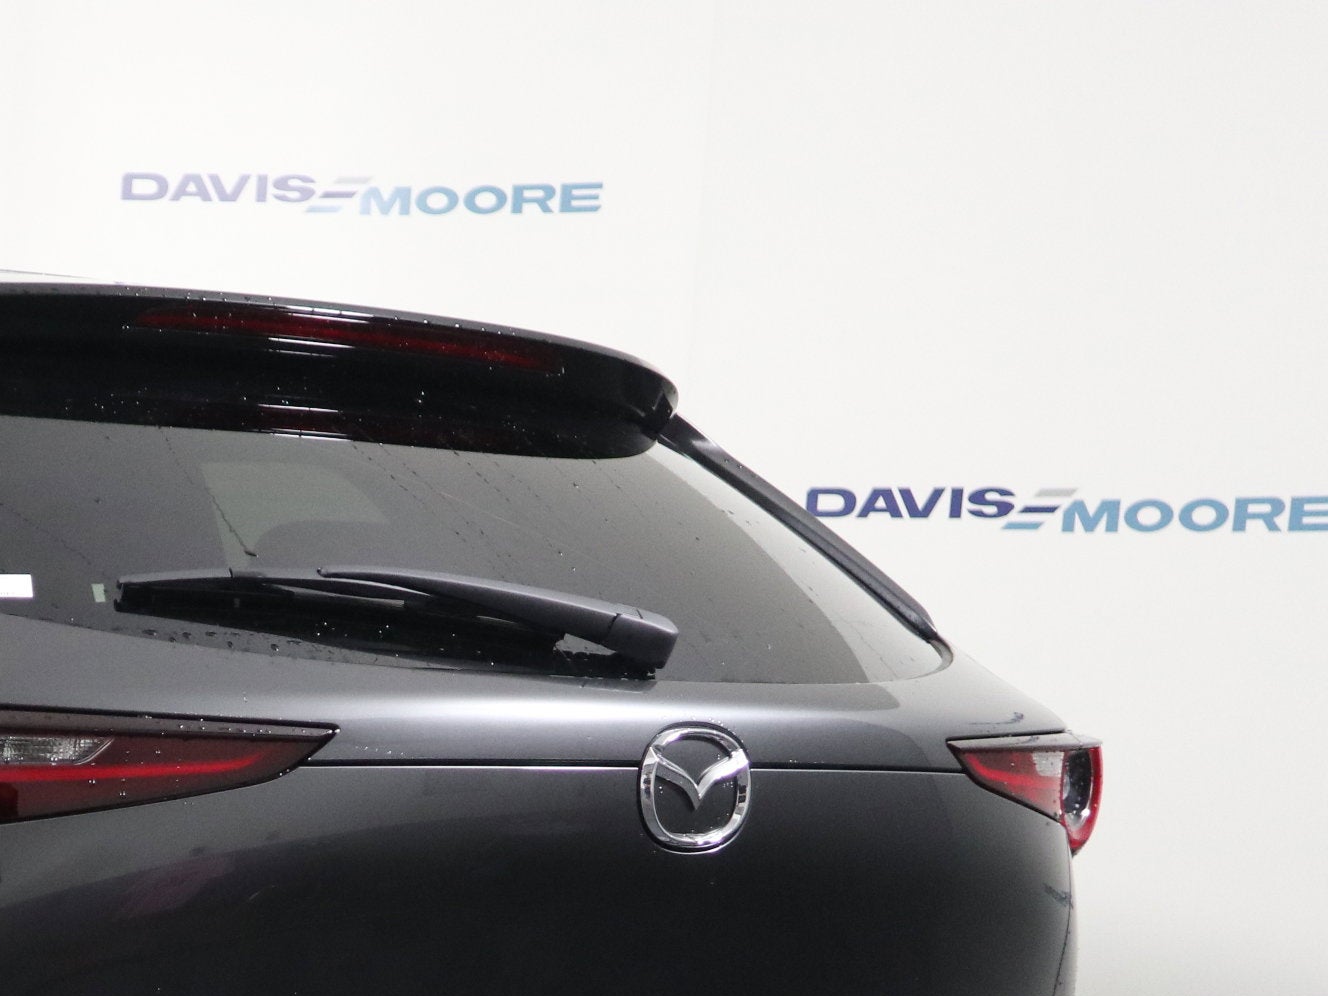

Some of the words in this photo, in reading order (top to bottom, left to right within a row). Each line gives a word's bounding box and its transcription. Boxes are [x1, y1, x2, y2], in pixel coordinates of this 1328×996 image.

[120, 172, 317, 204] DAVIS
[359, 181, 604, 216] MOORE
[806, 486, 1015, 520] DAVIS
[1061, 495, 1328, 533] MOORE
